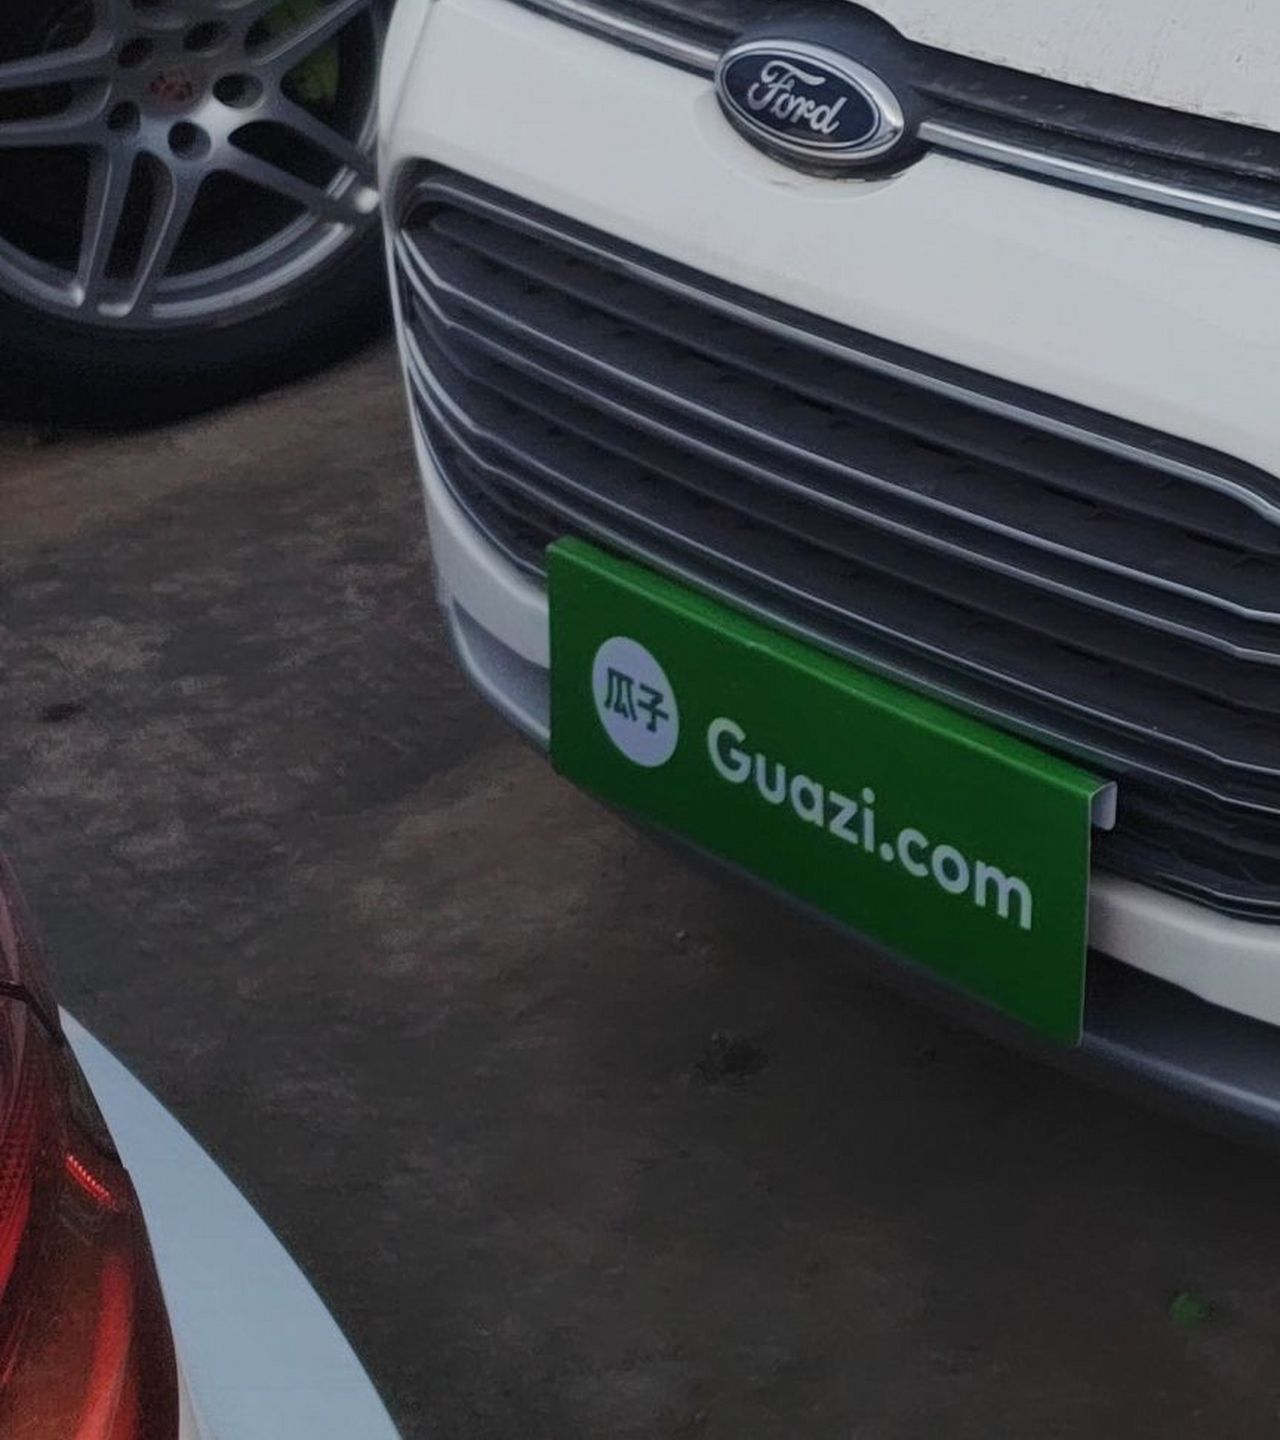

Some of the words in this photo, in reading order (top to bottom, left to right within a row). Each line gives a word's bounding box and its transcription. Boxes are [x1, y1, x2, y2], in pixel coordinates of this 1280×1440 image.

[747, 60, 847, 134] Ford
[603, 667, 669, 733] 瓜子
[706, 717, 1032, 930] Guazi.com
